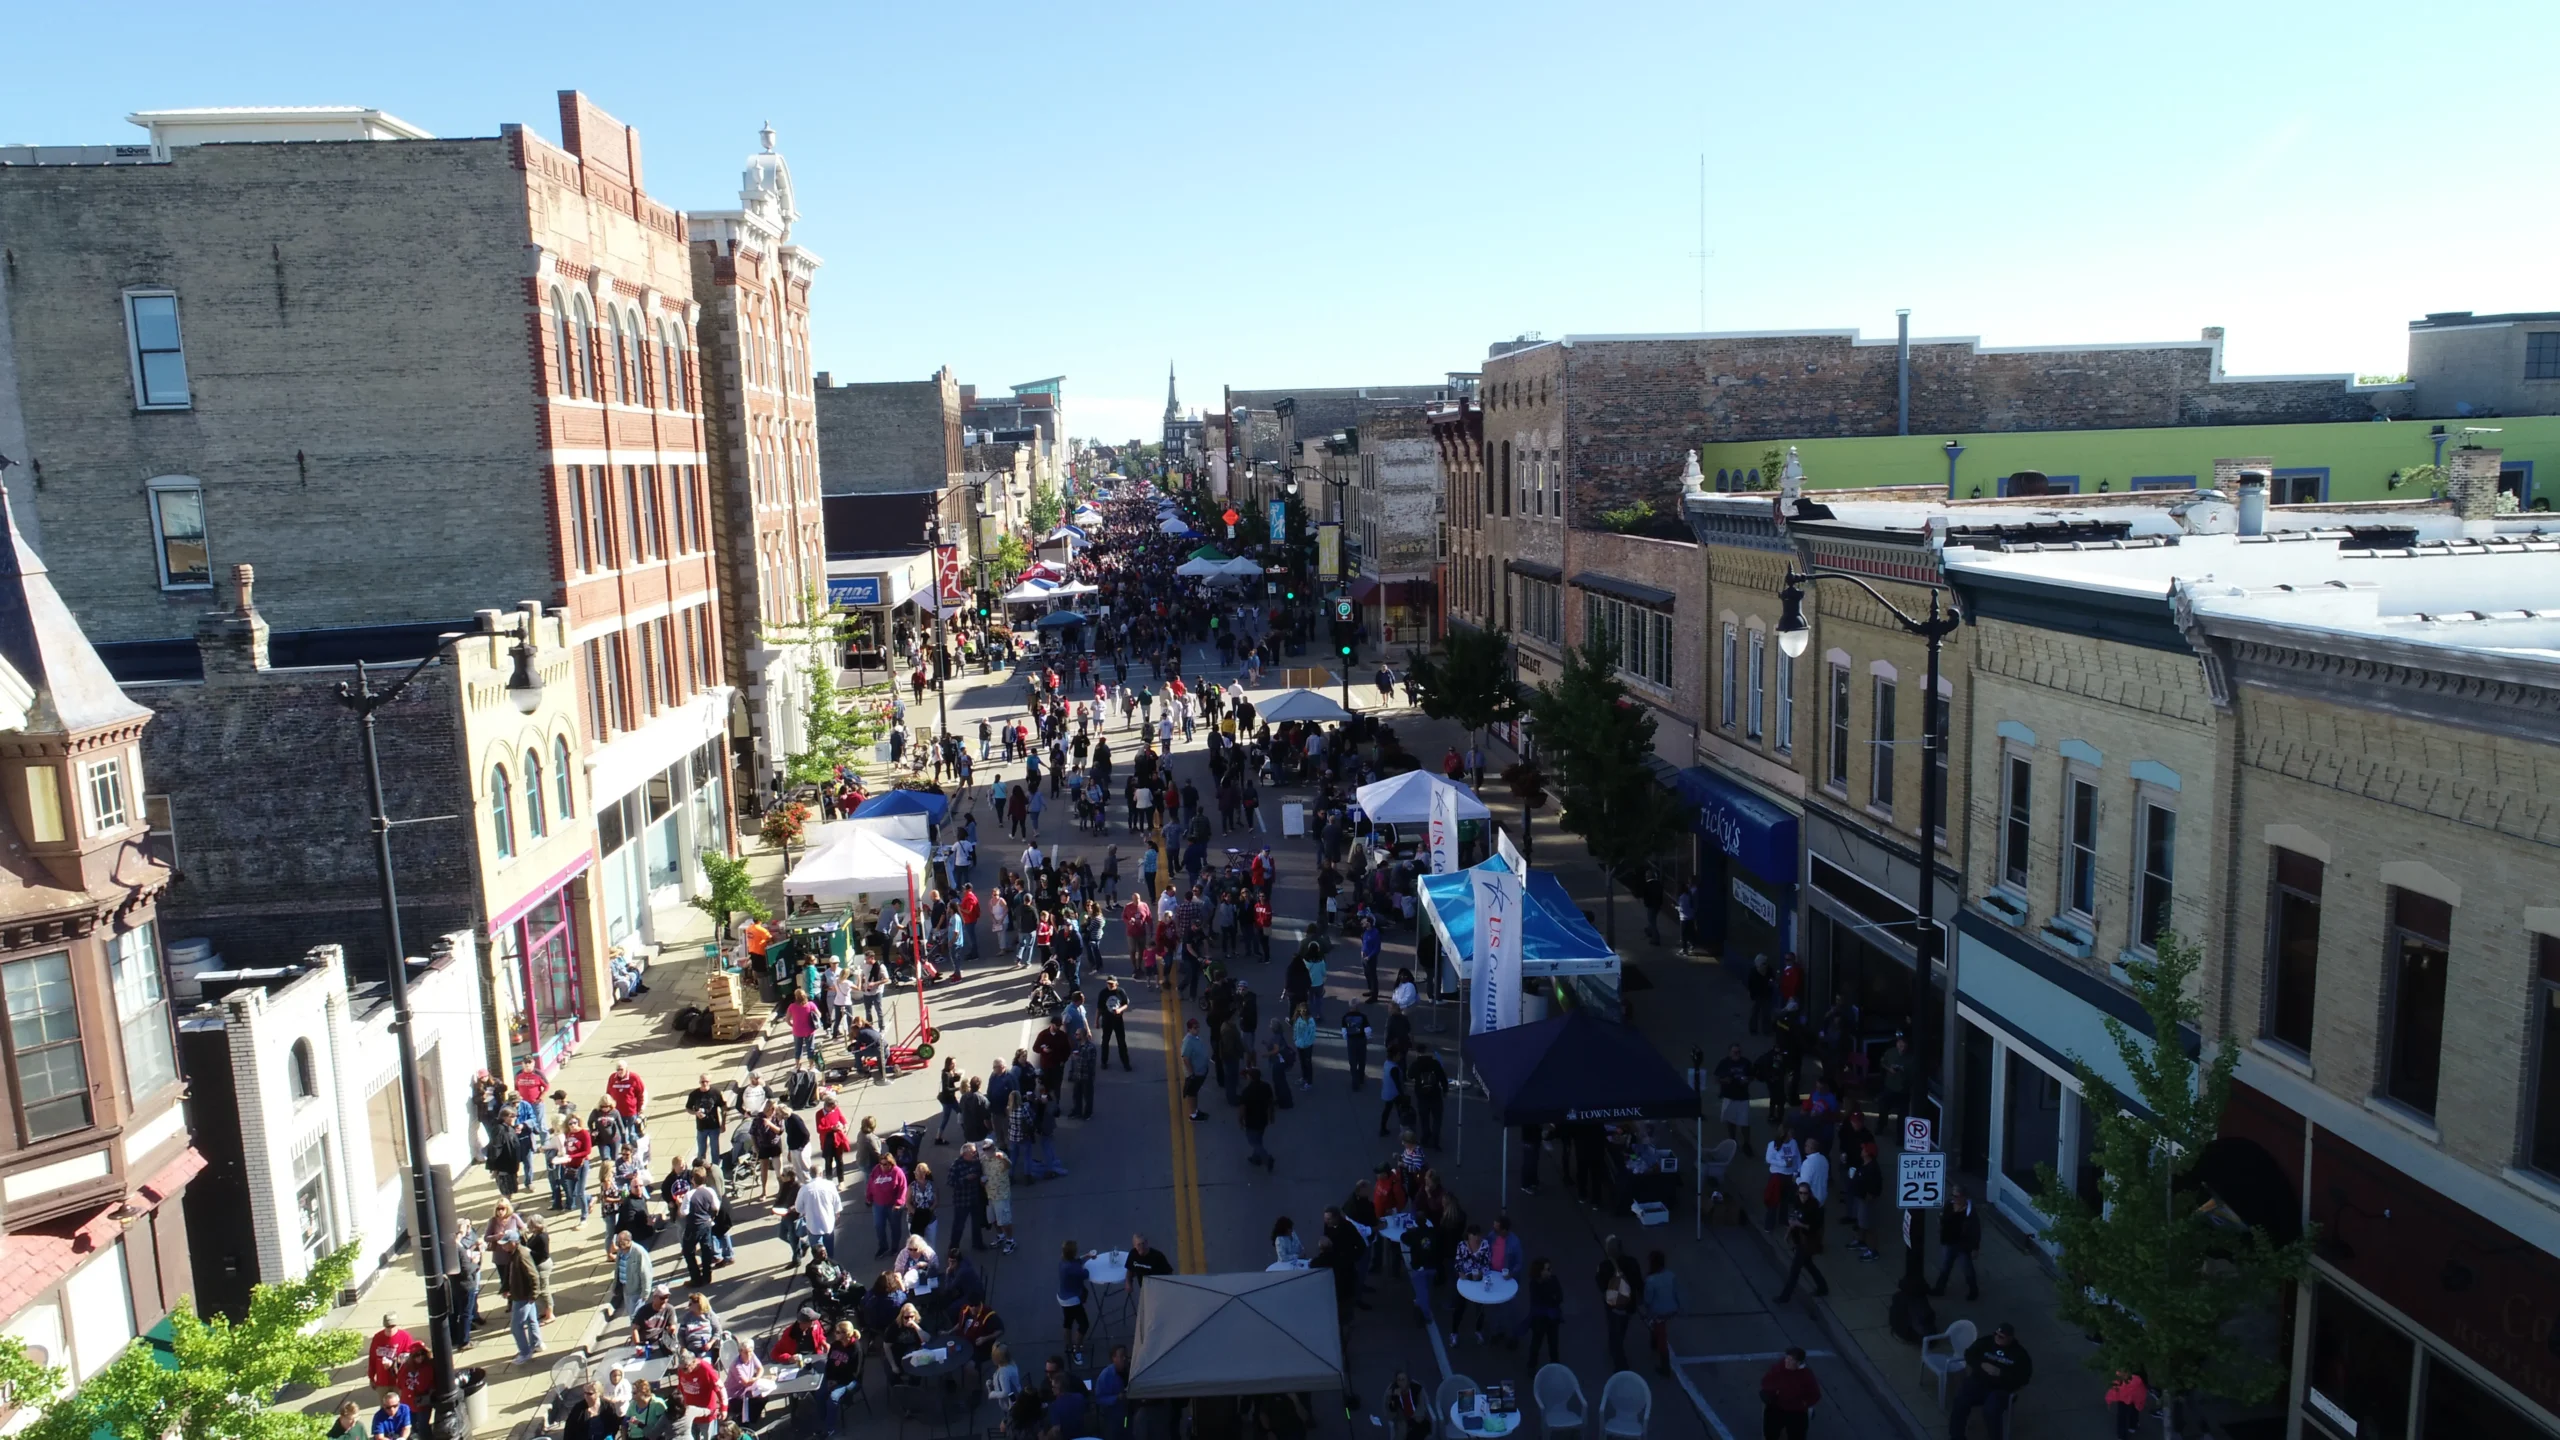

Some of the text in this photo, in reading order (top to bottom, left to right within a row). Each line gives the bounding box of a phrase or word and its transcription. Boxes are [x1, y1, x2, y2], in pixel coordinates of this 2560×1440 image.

[1519, 652, 1541, 675] LEGACY
[1700, 801, 1741, 852] ricky's
[1579, 1106, 1644, 1119] TOWN BANK
[1906, 1138, 1928, 1146] ANYTIME
[1903, 1160, 1941, 1168] SPEED
[1906, 1171, 1936, 1180] LIMIT
[1902, 1182, 1939, 1201] 25
[2454, 1317, 2560, 1405] RESTAU
